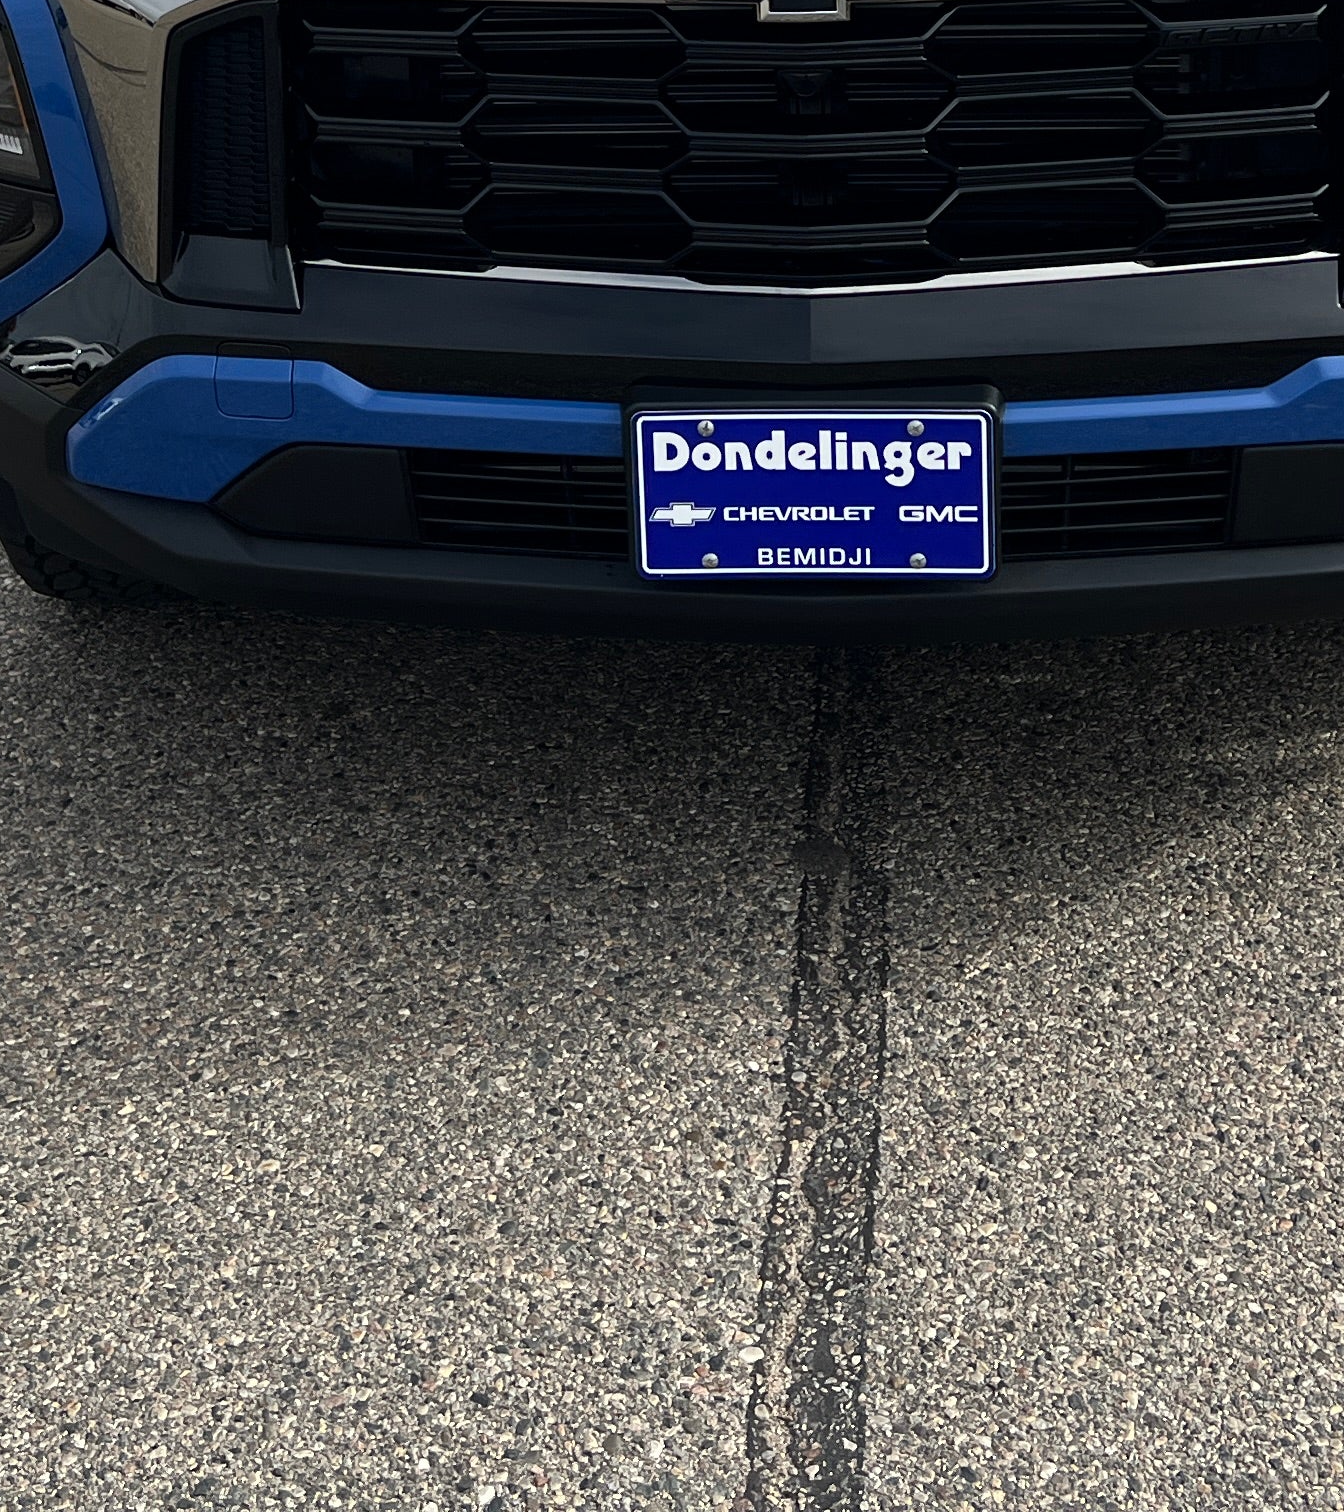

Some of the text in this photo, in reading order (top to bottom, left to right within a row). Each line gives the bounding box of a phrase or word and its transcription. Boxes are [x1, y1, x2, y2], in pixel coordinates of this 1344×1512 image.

[652, 430, 973, 487] Dondelinger
[723, 505, 979, 523] CHEVROLET GMC
[757, 547, 872, 566] BEMIDJI
